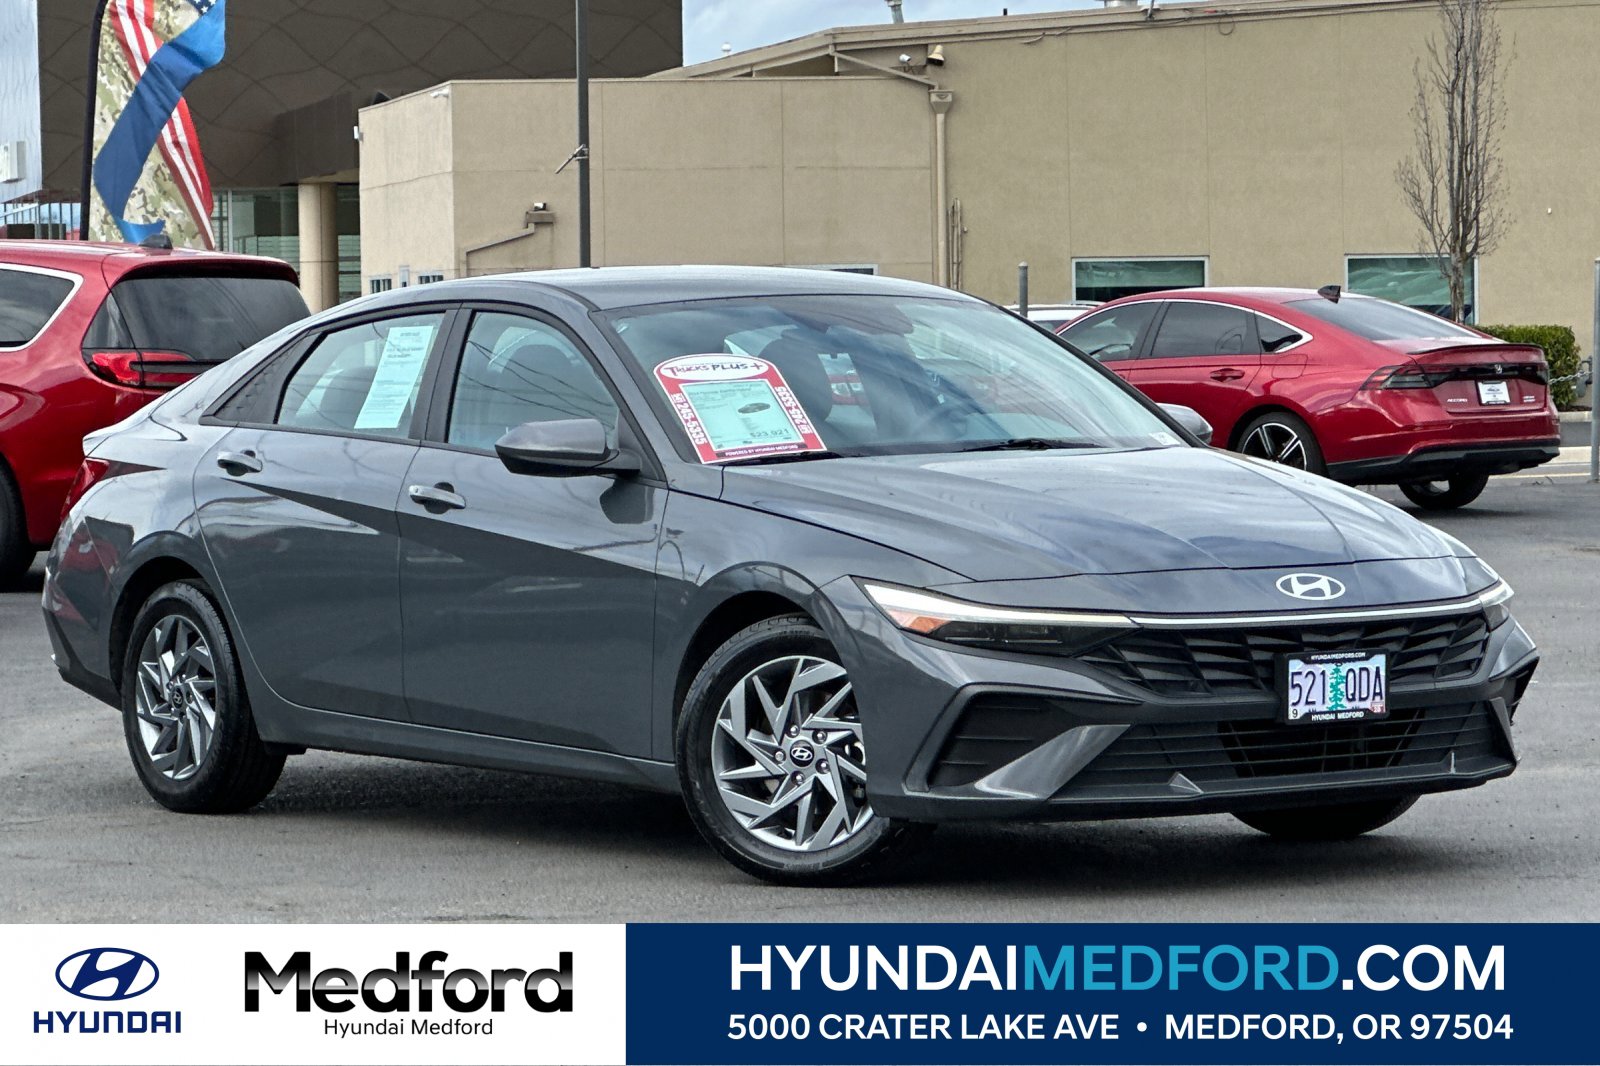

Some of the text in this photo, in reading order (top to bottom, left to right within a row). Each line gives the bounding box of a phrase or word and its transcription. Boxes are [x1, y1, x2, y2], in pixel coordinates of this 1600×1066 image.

[1311, 652, 1366, 660] HYUNDAIMEDFORD.COM
[1291, 666, 1383, 707] 521 QDA
[1292, 709, 1298, 718] 9
[1311, 711, 1364, 721] HYUNDAI MEDFORD
